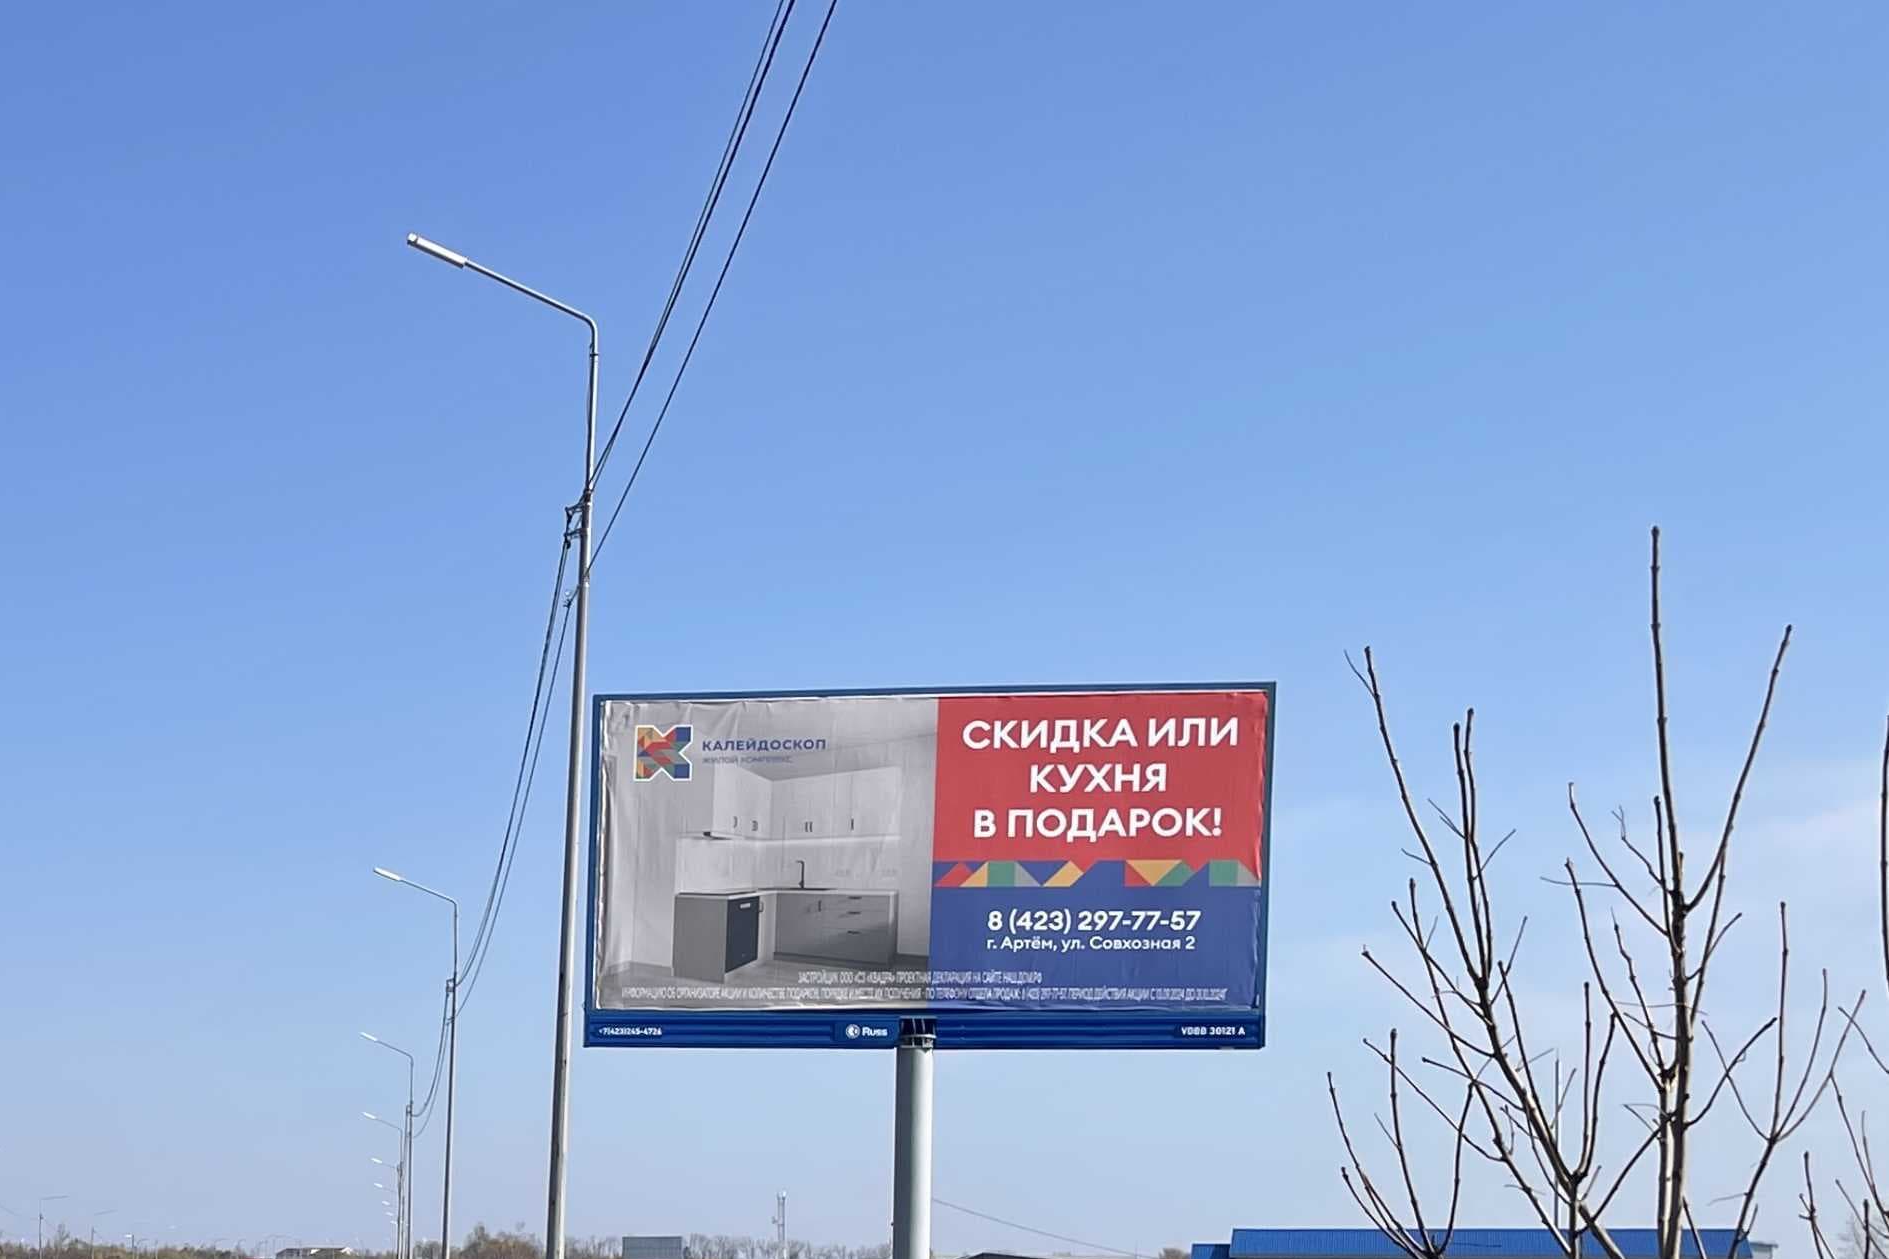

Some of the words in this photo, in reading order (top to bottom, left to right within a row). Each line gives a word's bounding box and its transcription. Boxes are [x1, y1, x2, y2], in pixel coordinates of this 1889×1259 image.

[702, 737, 827, 751] КАЛЕЙДОСКОП
[963, 718, 1138, 753] СКИДКА
[1148, 717, 1239, 747] ИЛИ
[1030, 763, 1167, 793] КУХНЯ
[973, 809, 996, 838] В
[1008, 807, 1222, 842] ПОДАРОК!
[987, 910, 1003, 931] 8
[1009, 909, 1072, 934] (423)
[1078, 910, 1202, 931] 297-77-57
[986, 939, 997, 950] г.
[1000, 936, 1057, 953] Артём,
[1061, 939, 1085, 953] ул.
[1089, 936, 1181, 950] Совхозная
[1185, 936, 1196, 950] 2
[862, 1026, 888, 1036] Russ
